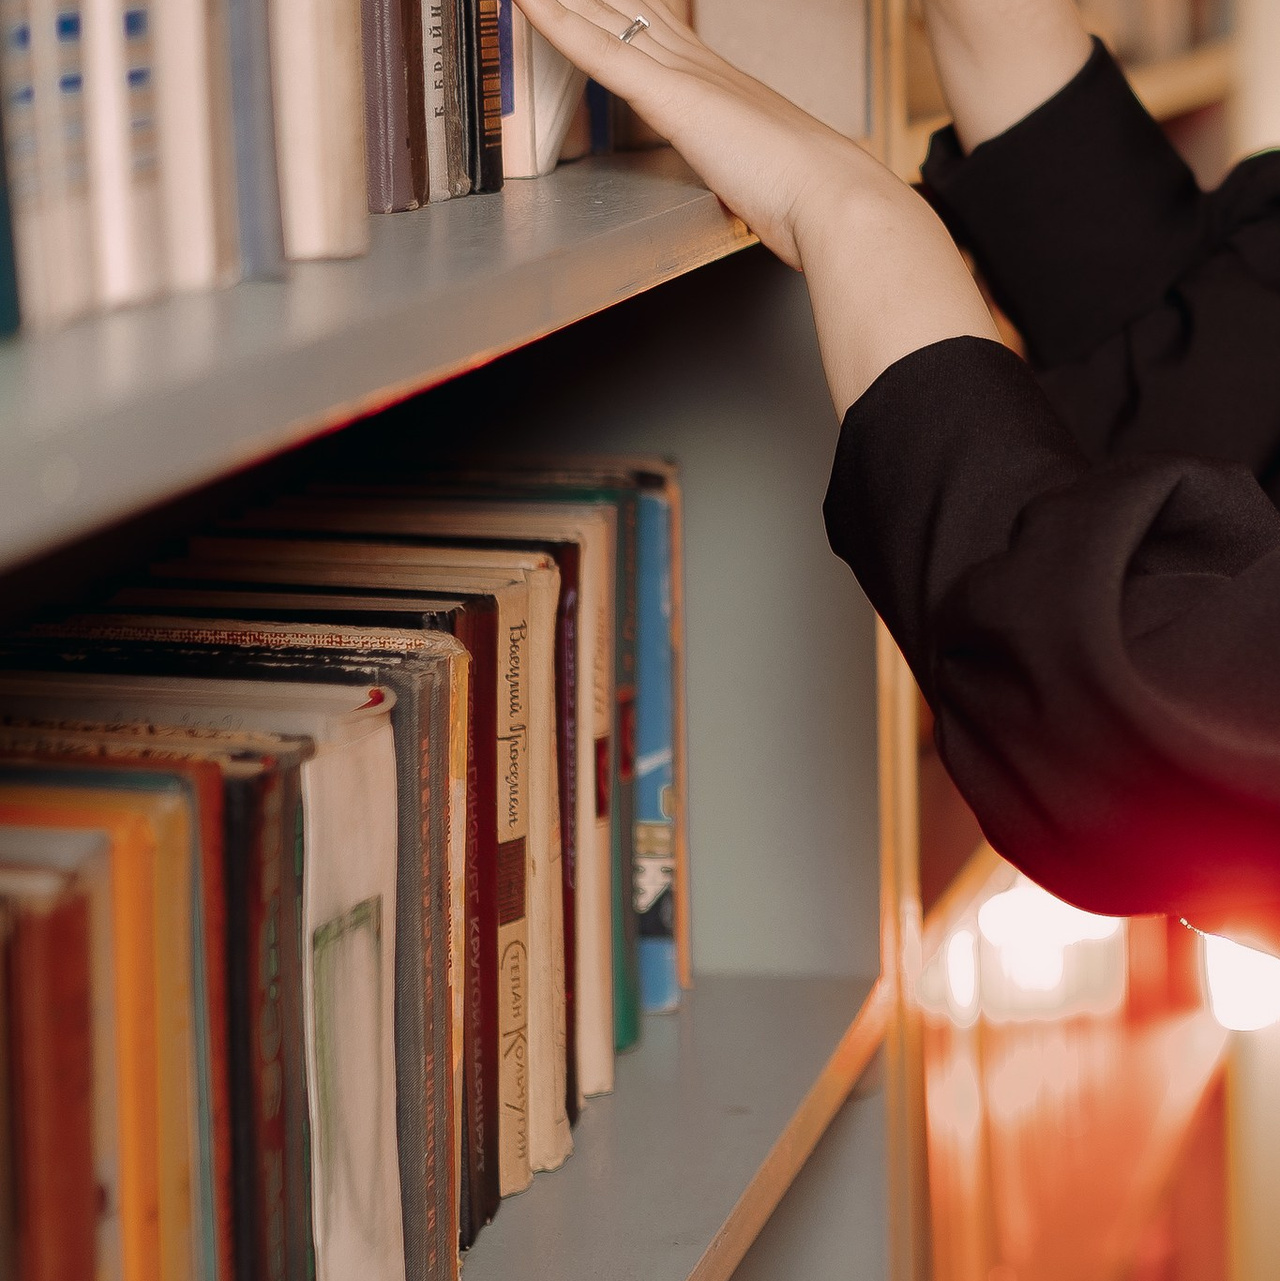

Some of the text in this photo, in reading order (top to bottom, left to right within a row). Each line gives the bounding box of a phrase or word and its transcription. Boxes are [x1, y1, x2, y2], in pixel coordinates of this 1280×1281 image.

[497, 620, 528, 828] Василий Гроссман
[467, 766, 479, 903] ГИНЗБУРГ
[474, 1038, 486, 1173] МАРШРУТ
